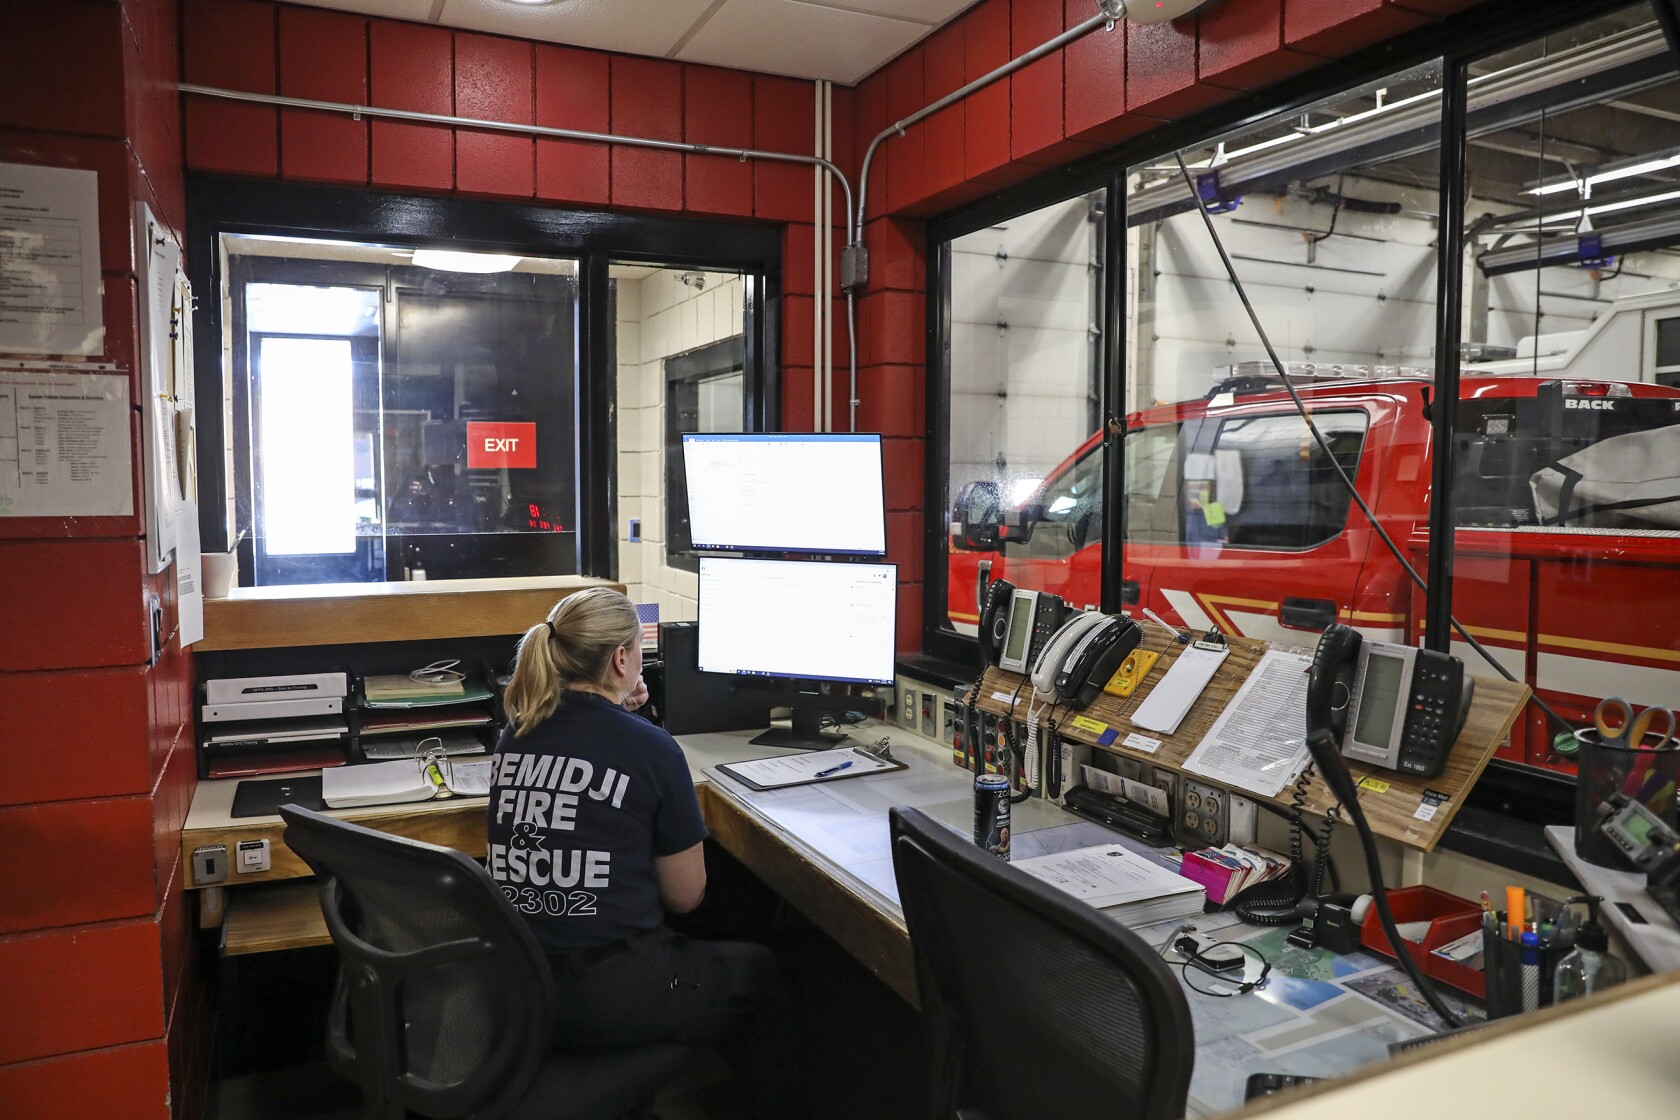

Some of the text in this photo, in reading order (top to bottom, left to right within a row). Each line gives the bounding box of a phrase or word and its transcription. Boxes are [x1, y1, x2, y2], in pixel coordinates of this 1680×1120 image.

[1565, 399, 1614, 411] BACK
[485, 438, 519, 452] EXIT
[496, 789, 579, 831] FIRE
[510, 821, 547, 852] &
[500, 886, 597, 916] 2302
